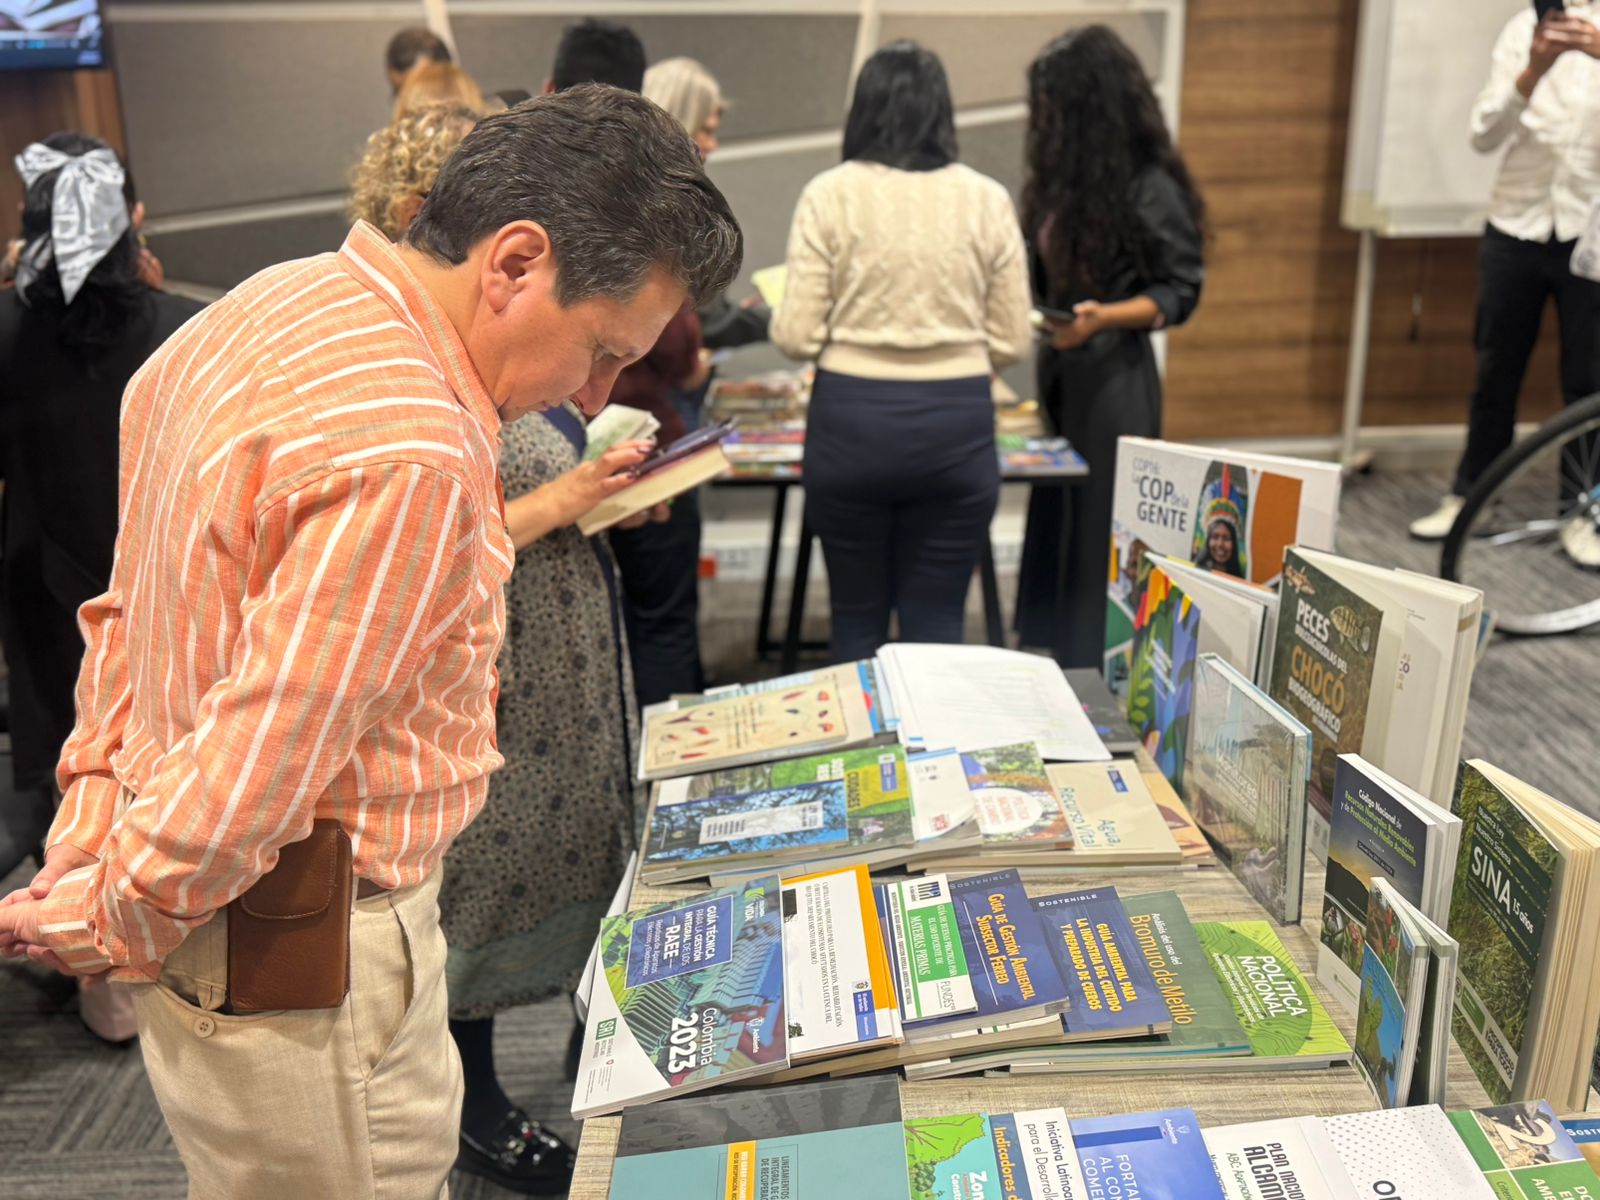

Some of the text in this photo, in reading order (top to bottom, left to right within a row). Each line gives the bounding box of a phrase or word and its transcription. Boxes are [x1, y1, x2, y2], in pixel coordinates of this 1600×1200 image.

[1139, 476, 1174, 503] COP
[1136, 501, 1187, 531] GENTE
[1296, 597, 1329, 643] PECES
[1290, 645, 1345, 716] CHOCÓ
[1288, 676, 1340, 734] BIOGEOGRÁFICO
[1059, 786, 1086, 824] Recurso
[1365, 805, 1387, 831] Naturales
[1374, 801, 1396, 826] Nacional
[950, 874, 1011, 889] SOSTENIBLE
[1471, 845, 1510, 915] SINA
[695, 909, 703, 925] PARA
[744, 903, 752, 922] VIDA
[1039, 894, 1097, 907] SOSTENIBLE
[1512, 897, 1534, 935] 15 años
[662, 925, 680, 959] RAEE
[682, 911, 692, 966] INTEGRAL DE LOS
[693, 934, 703, 961] GESTIÓN
[705, 905, 718, 960] GUÍA TÉCNICA
[910, 915, 931, 975] MATERIAS PRIMAS
[975, 914, 1010, 983] SUBSECTOR FERREO
[986, 894, 1036, 1000] GUÍA DE GESTIÓN AMBIENTAL
[1061, 930, 1085, 970] PREPARADO
[1151, 913, 1182, 966] Análisis del uso del
[1074, 918, 1122, 1012] LA INDUSTRIA DEL CURTIDO
[1075, 969, 1090, 982] DE
[1096, 923, 1137, 1002] GUÍA AMBIENTAL PARA
[1129, 915, 1199, 1026] Bromuro de Metilo
[1080, 980, 1102, 1011] CUEROS
[1237, 956, 1284, 1017] NACIONAL
[1255, 955, 1307, 1016] POLÍTICA
[598, 1021, 612, 1038] SRI
[668, 1013, 698, 1073] 2023
[700, 1008, 718, 1065] Colombia
[1023, 1122, 1040, 1146] para
[1031, 1145, 1047, 1155] el
[1045, 1120, 1066, 1161] Iniciativa
[1163, 1118, 1178, 1144] Ambiente
[1493, 1114, 1556, 1151] 2
[760, 1158, 769, 1168] DE
[771, 1157, 779, 1185] INTEGRAL
[780, 1155, 790, 1199] LINEAMIENTOS
[993, 1126, 1018, 1192] Indicadores
[1097, 1155, 1115, 1173] AL
[1225, 1151, 1242, 1168] ABC:
[1263, 1141, 1306, 1200] PLAN NACIO
[771, 1186, 778, 1194] DE
